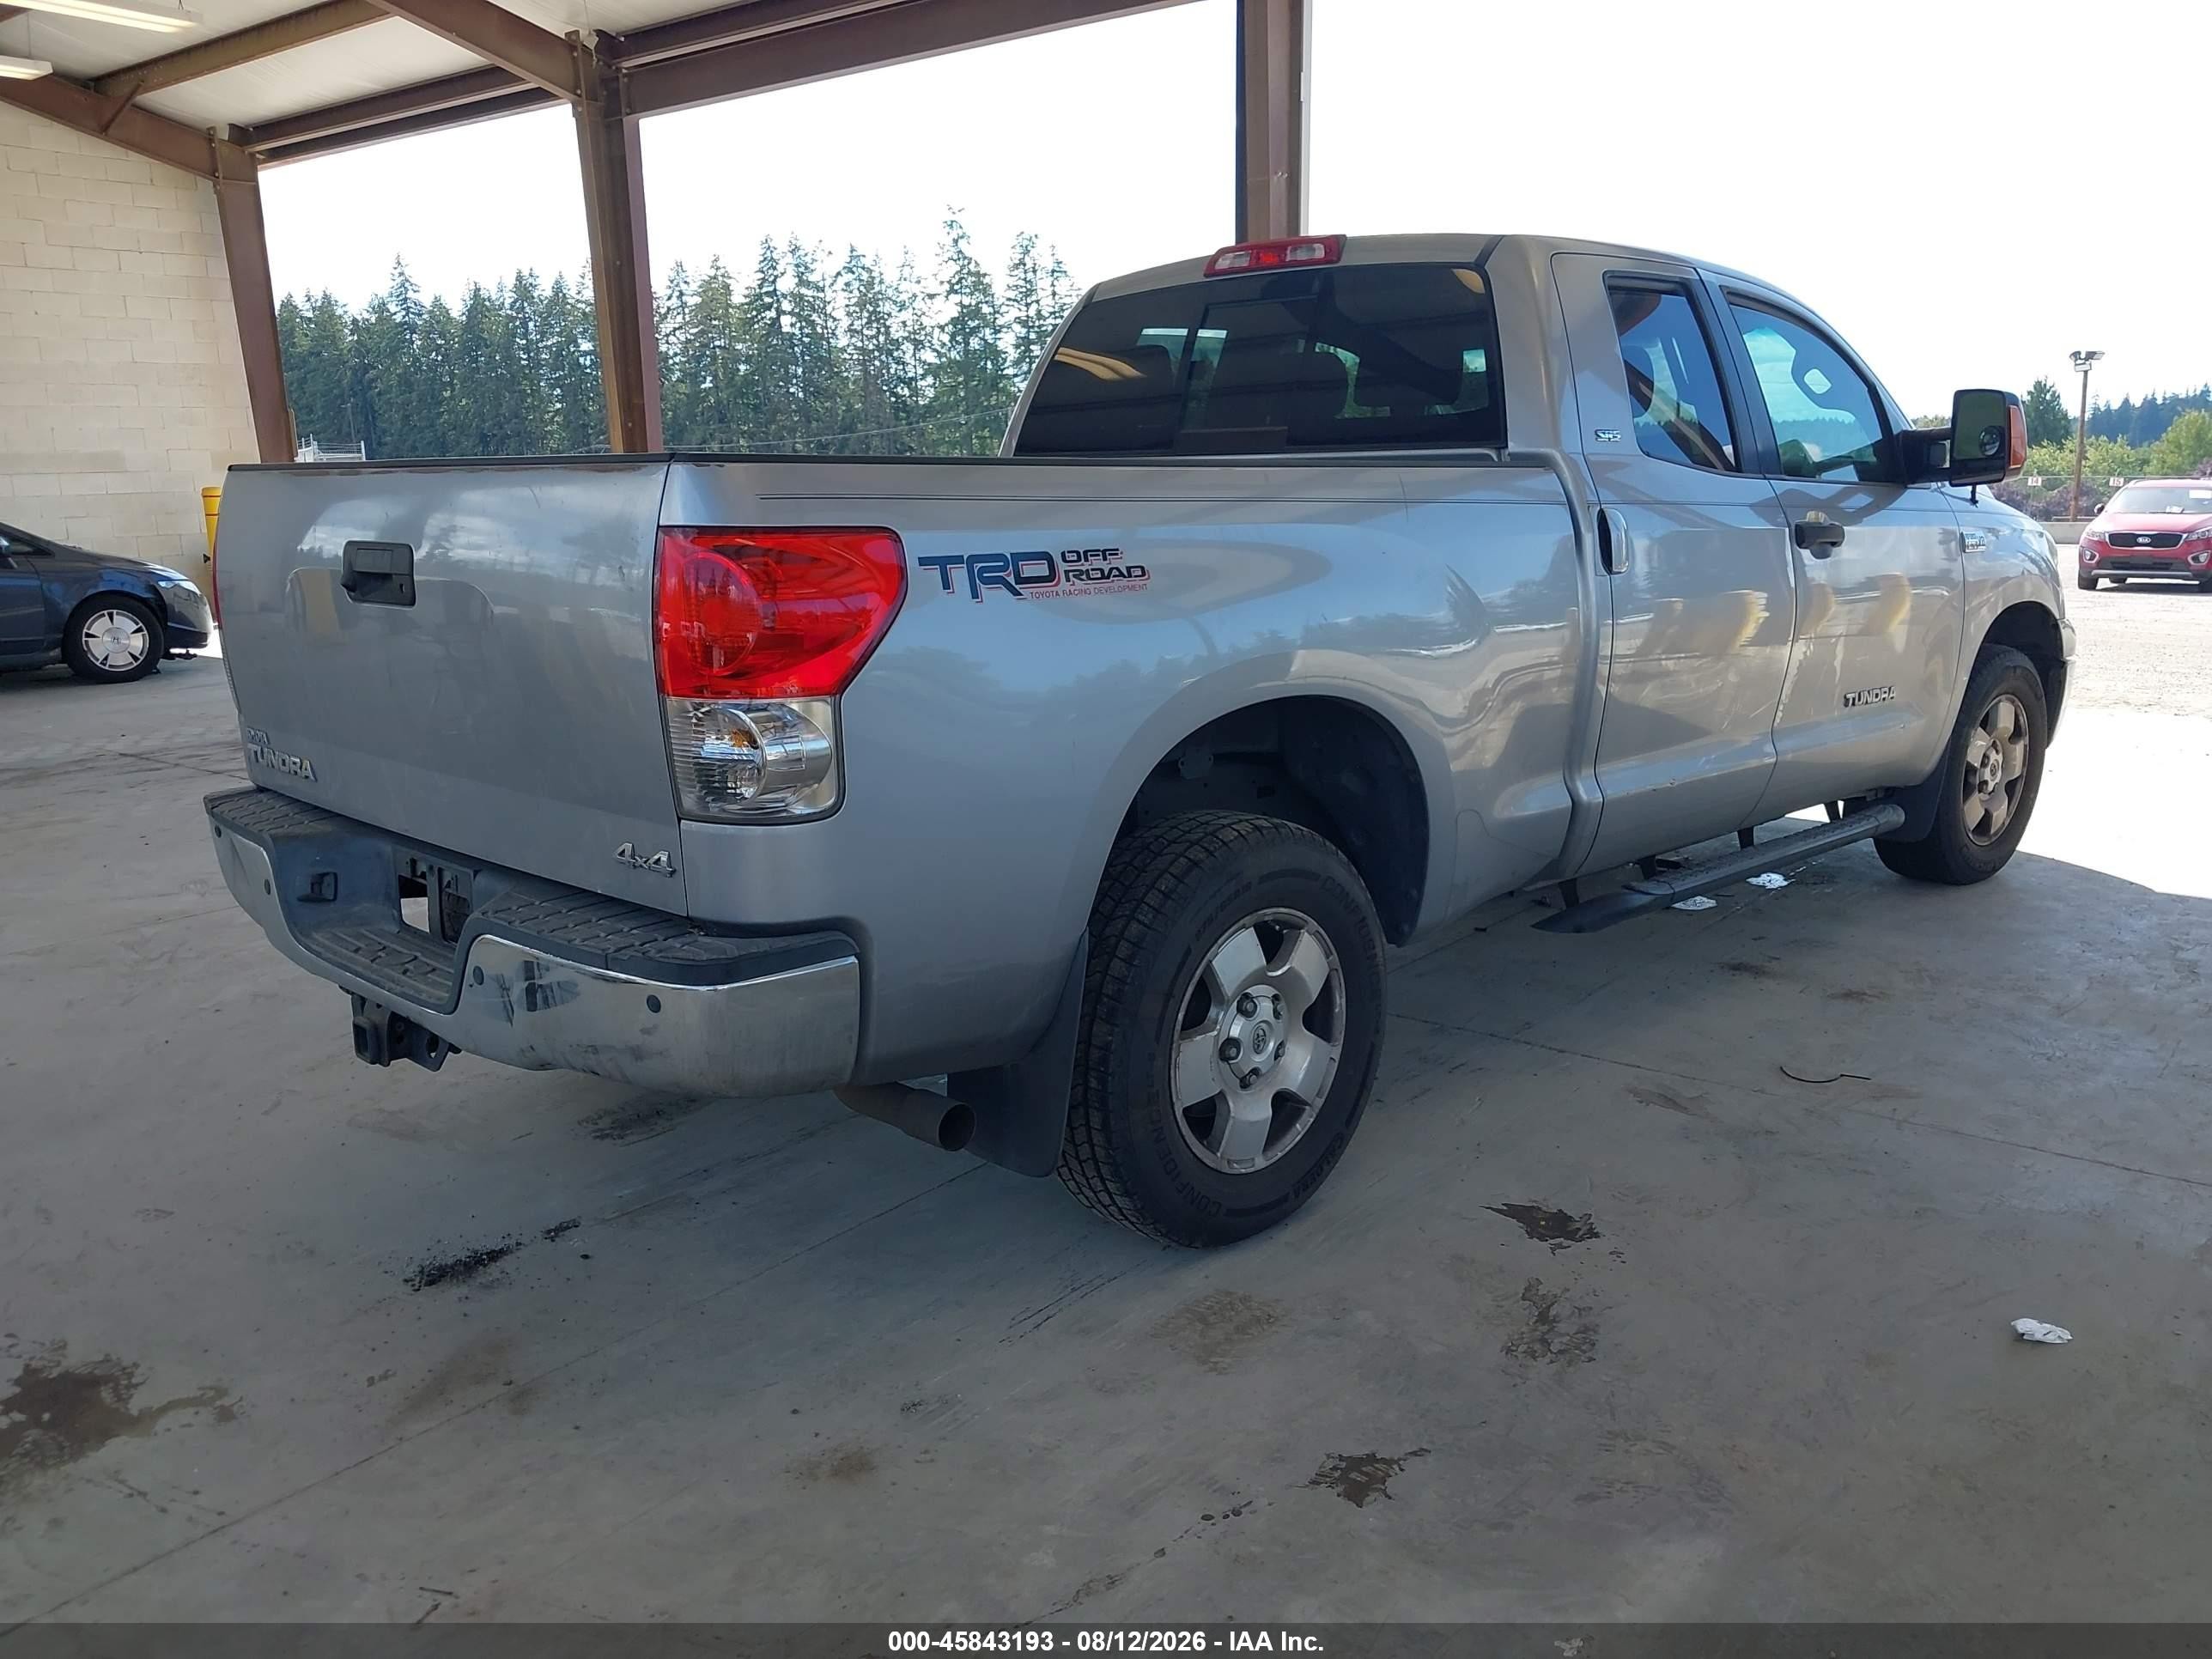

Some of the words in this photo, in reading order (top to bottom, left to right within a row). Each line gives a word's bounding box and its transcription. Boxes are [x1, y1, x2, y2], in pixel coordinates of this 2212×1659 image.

[1060, 548, 1122, 565] OFF
[917, 550, 1060, 603] TRD
[1064, 564, 1151, 586] ROAD
[1030, 590, 1060, 600] TOYOTA
[1061, 587, 1092, 598] RACING
[1093, 583, 1148, 595] DEVELOPMENT
[1844, 685, 1897, 708] TUNDRA
[246, 743, 318, 782] TUNDRA
